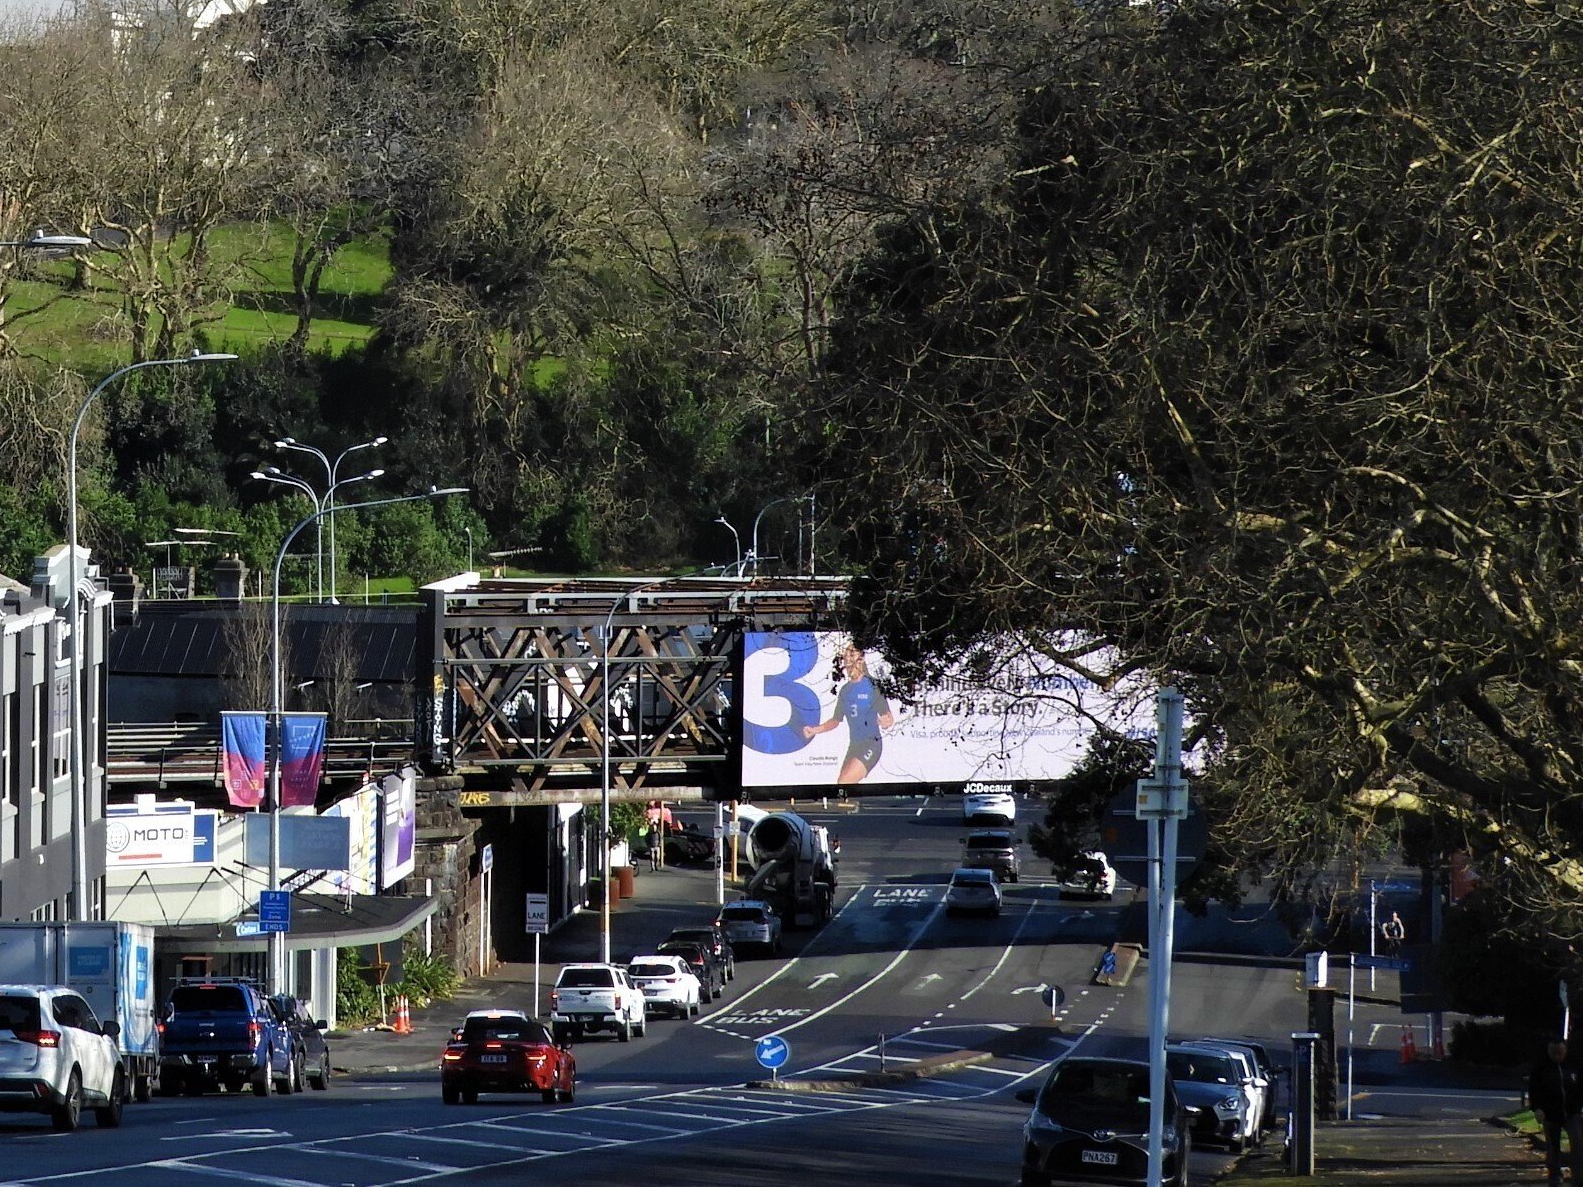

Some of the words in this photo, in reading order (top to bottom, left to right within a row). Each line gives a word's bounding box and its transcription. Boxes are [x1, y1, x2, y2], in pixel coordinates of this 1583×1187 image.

[963, 782, 1013, 794] JCDecaux
[134, 828, 184, 841] MOTO
[873, 888, 932, 897] LANE
[1083, 1152, 1115, 1163] PNA267
